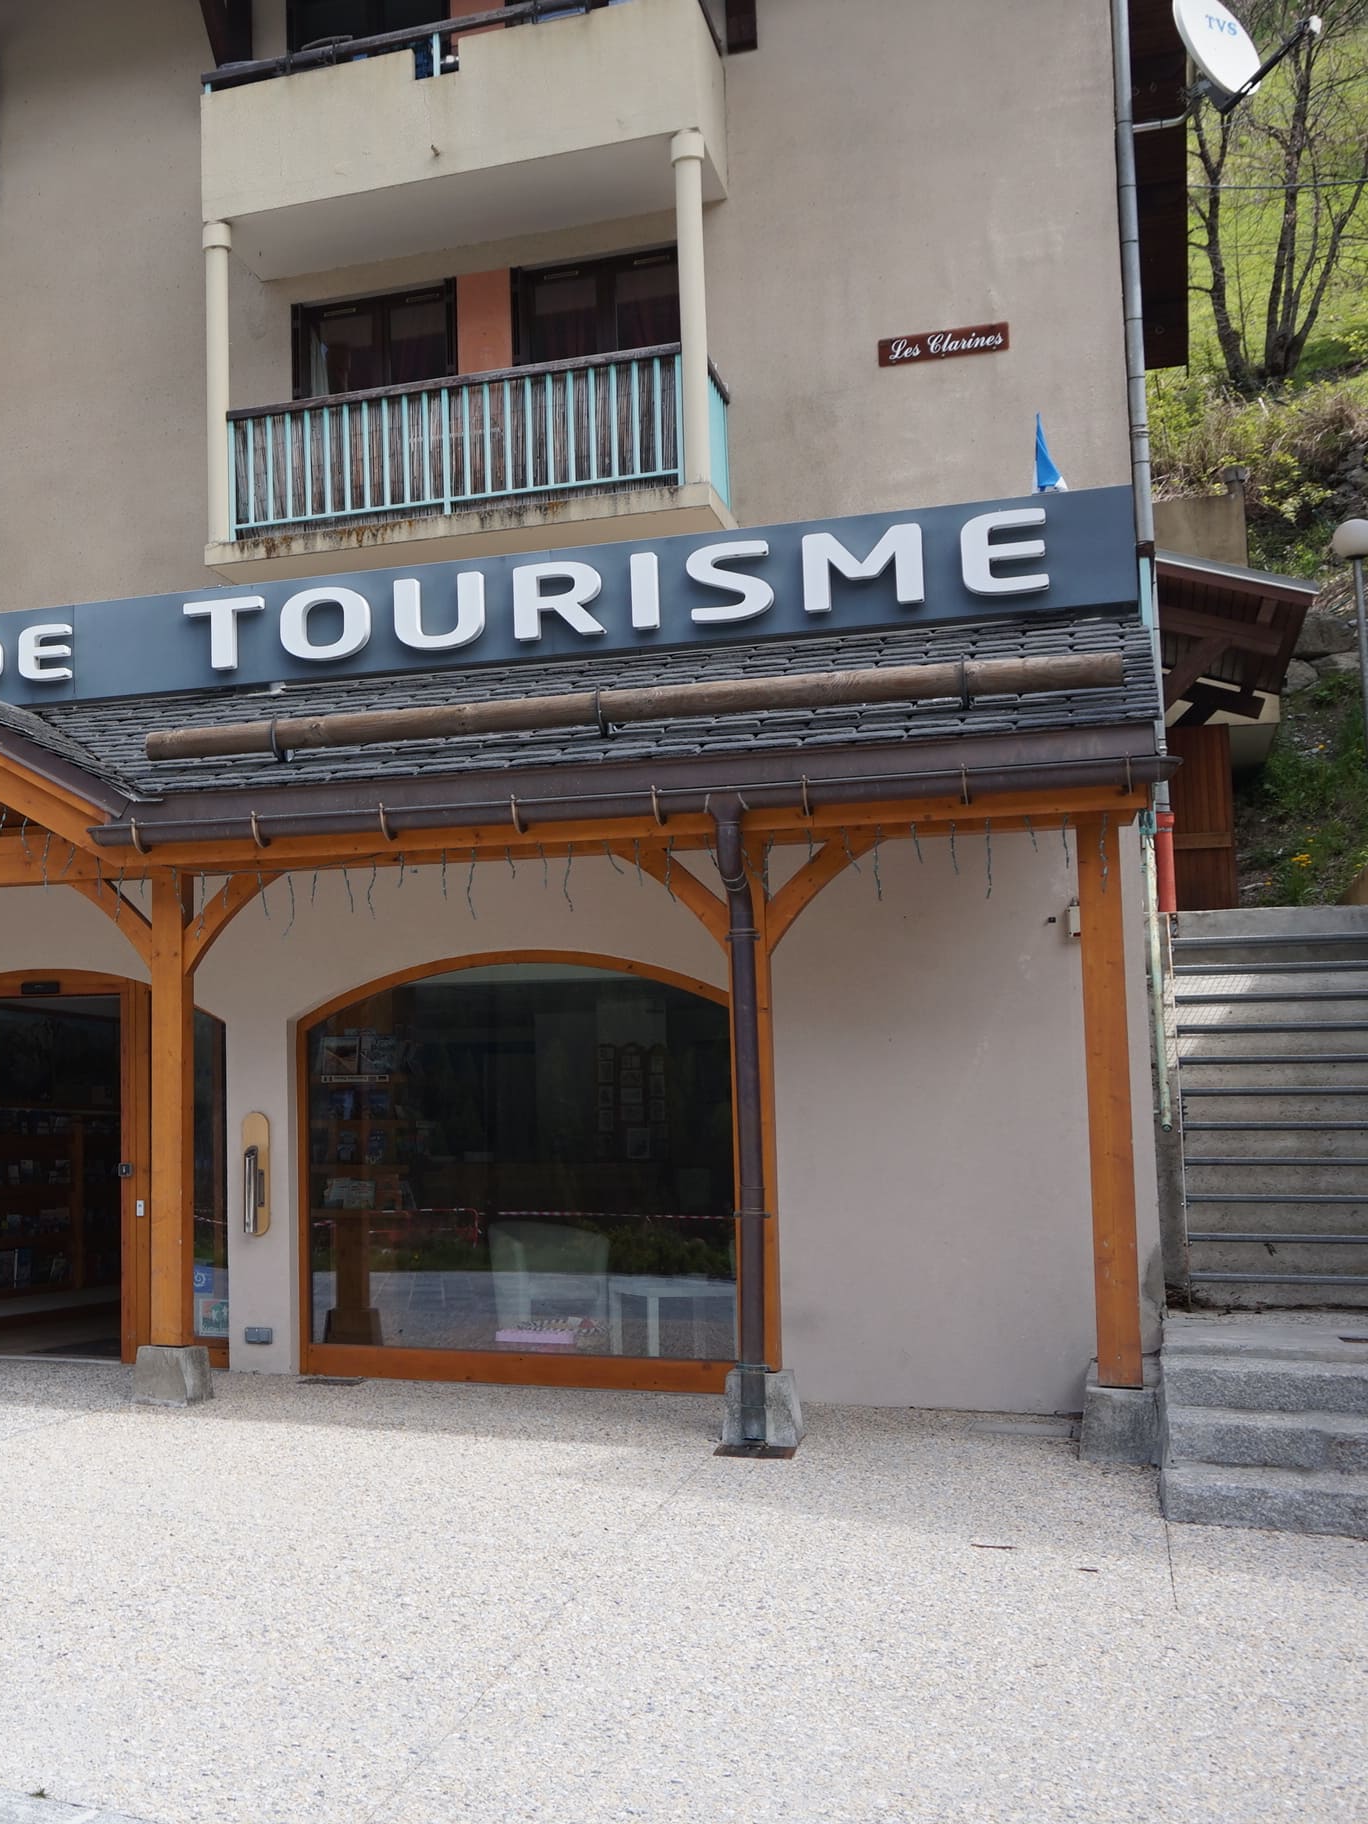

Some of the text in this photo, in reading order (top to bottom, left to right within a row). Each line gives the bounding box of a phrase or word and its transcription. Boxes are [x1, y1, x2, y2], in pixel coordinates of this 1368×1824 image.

[1206, 15, 1237, 36] TVS
[889, 331, 1003, 360] Les Clarines
[183, 507, 1049, 671] TOURISME
